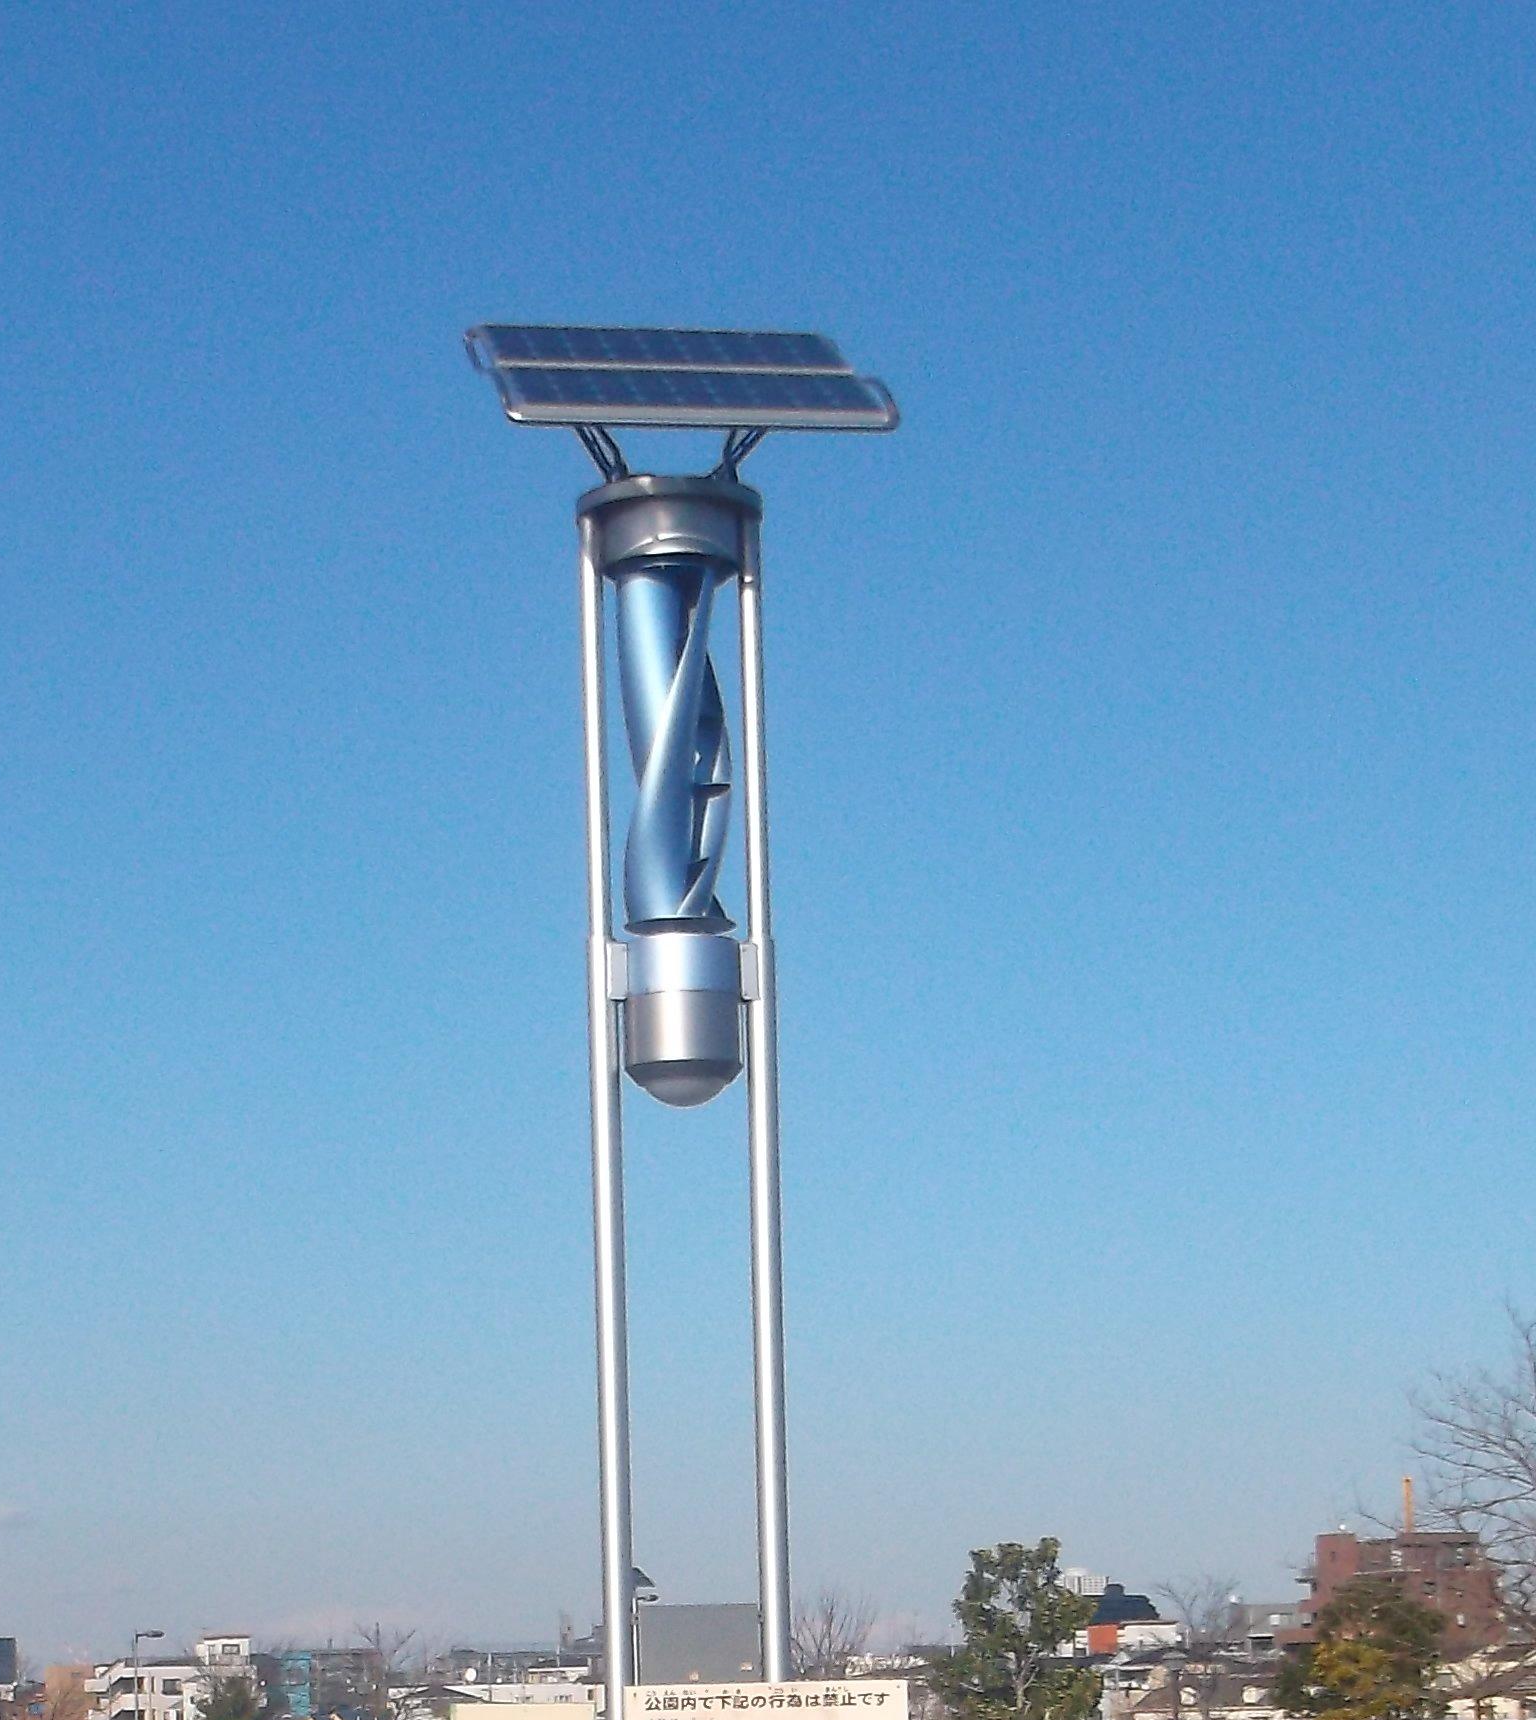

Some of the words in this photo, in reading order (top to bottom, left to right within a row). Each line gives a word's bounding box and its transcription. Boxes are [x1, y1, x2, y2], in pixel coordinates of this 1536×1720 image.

[645, 1692, 890, 1711] 公園内で下記の行為は禁止です
